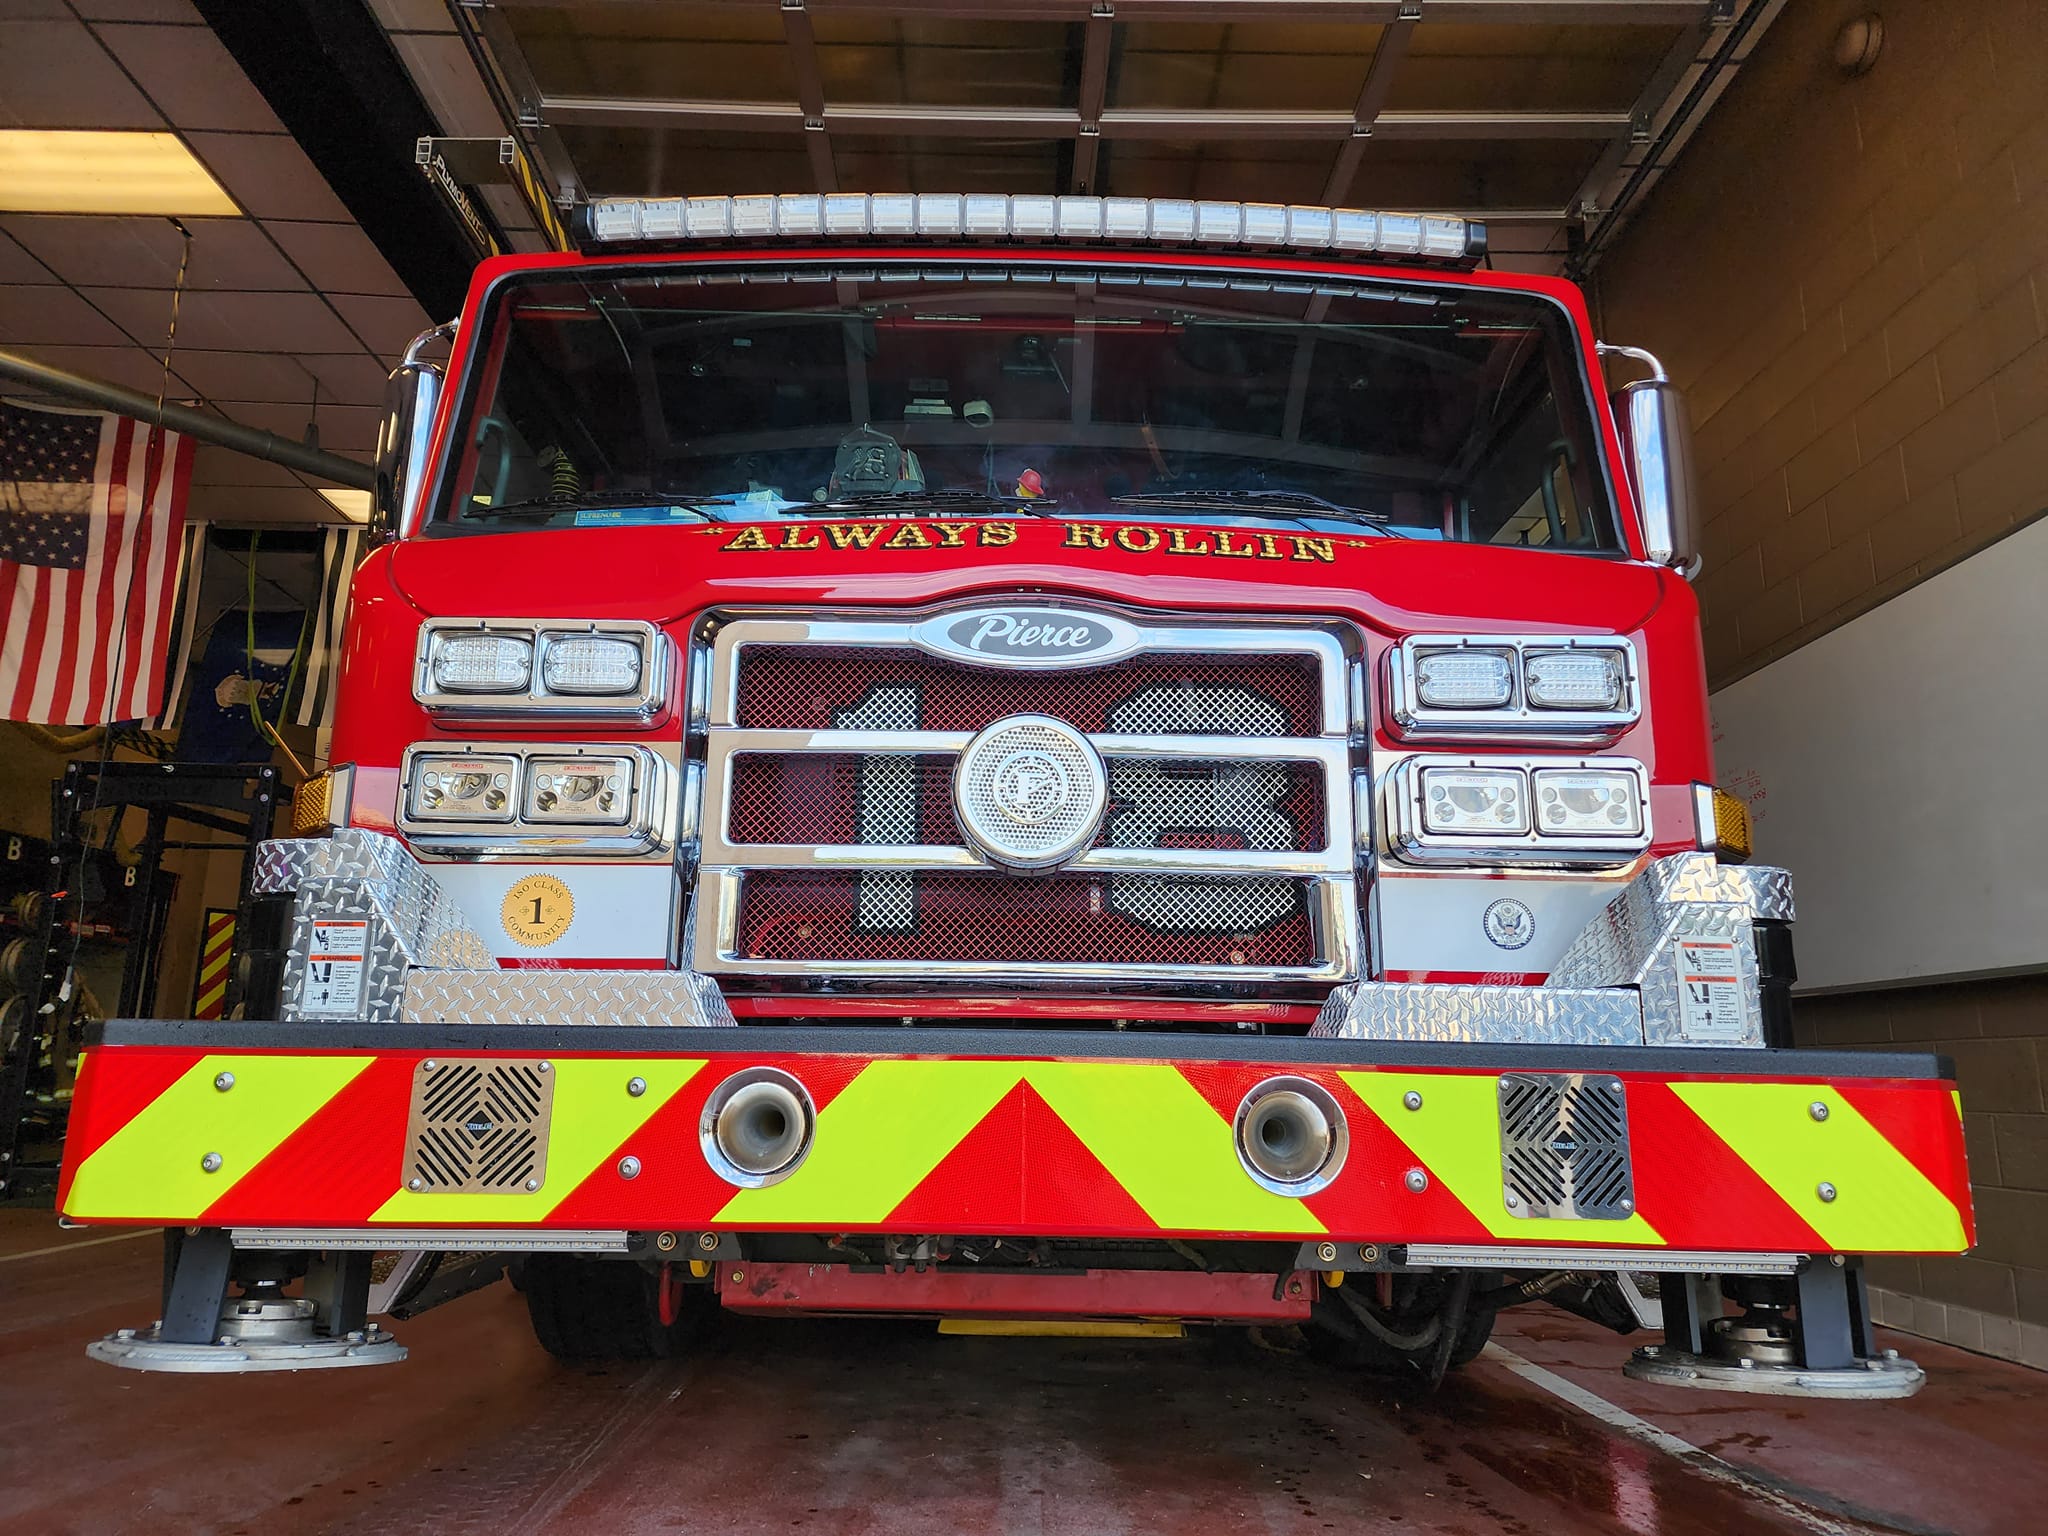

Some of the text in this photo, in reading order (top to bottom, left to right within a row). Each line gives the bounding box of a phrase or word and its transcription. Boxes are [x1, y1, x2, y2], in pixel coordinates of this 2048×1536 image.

[969, 614, 1092, 650] Pierce
[7, 837, 22, 861] B
[125, 866, 136, 887] B
[513, 880, 564, 900] ISO CLASS
[528, 896, 545, 924] 1
[508, 915, 565, 940] COMMUNITY
